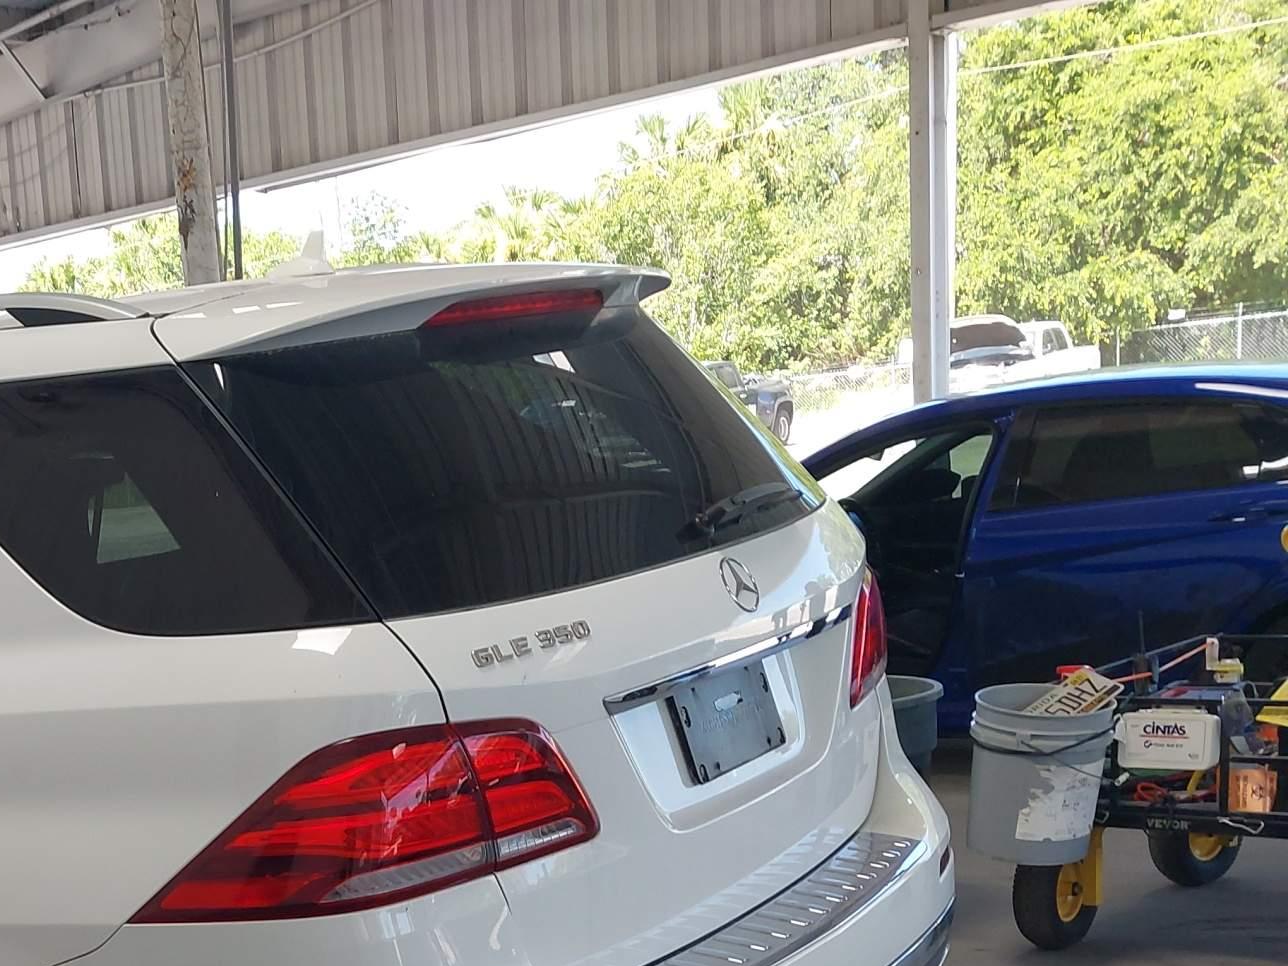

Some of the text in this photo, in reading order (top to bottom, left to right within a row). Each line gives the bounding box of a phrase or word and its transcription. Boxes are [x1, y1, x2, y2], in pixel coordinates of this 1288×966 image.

[471, 619, 591, 668] GLE 350
[1143, 721, 1187, 736] CINTAS
[1146, 818, 1190, 831] VEVOR
